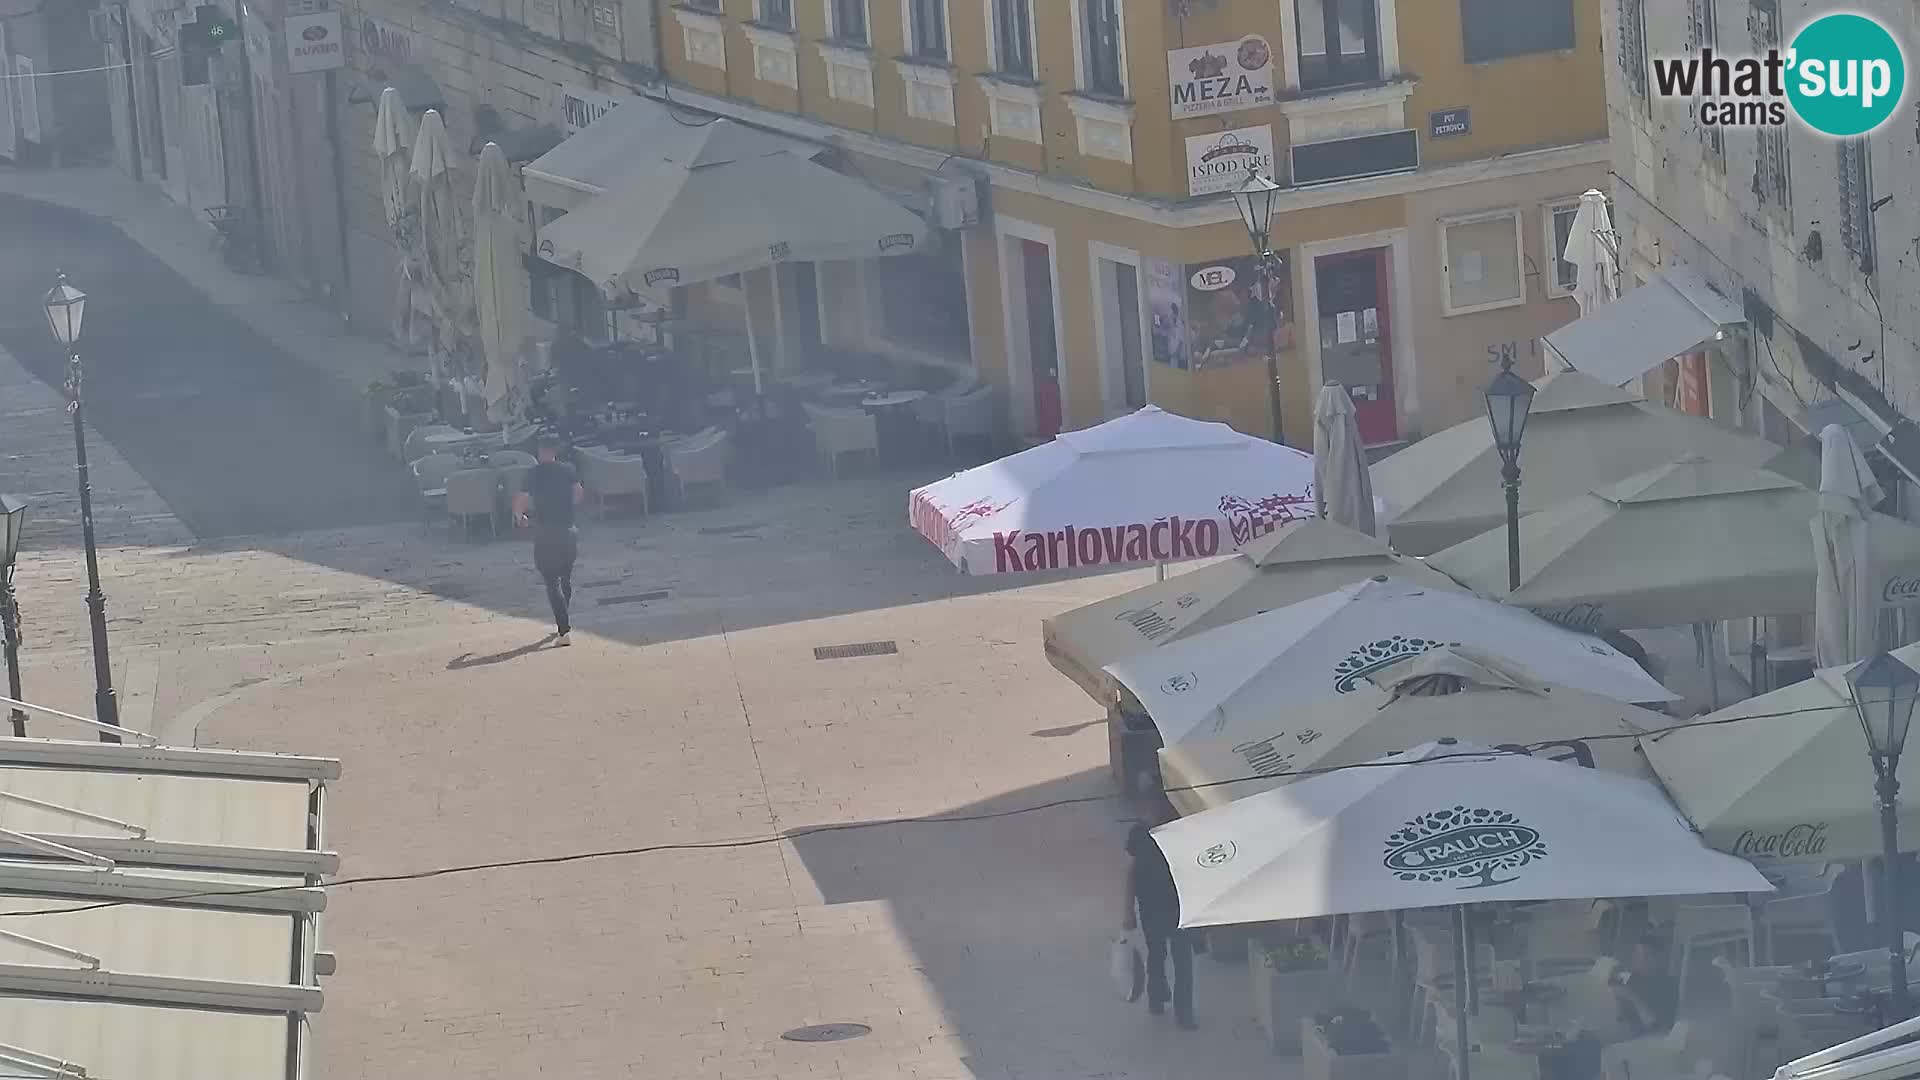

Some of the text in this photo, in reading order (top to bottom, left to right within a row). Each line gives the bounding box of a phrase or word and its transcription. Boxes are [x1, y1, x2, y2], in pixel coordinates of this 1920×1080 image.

[1174, 75, 1252, 104] MEZA
[1443, 113, 1456, 123] PUT
[1192, 160, 1238, 178] ISPOD
[992, 516, 1220, 573] Karlovačko
[1422, 830, 1522, 861] RAUCH
